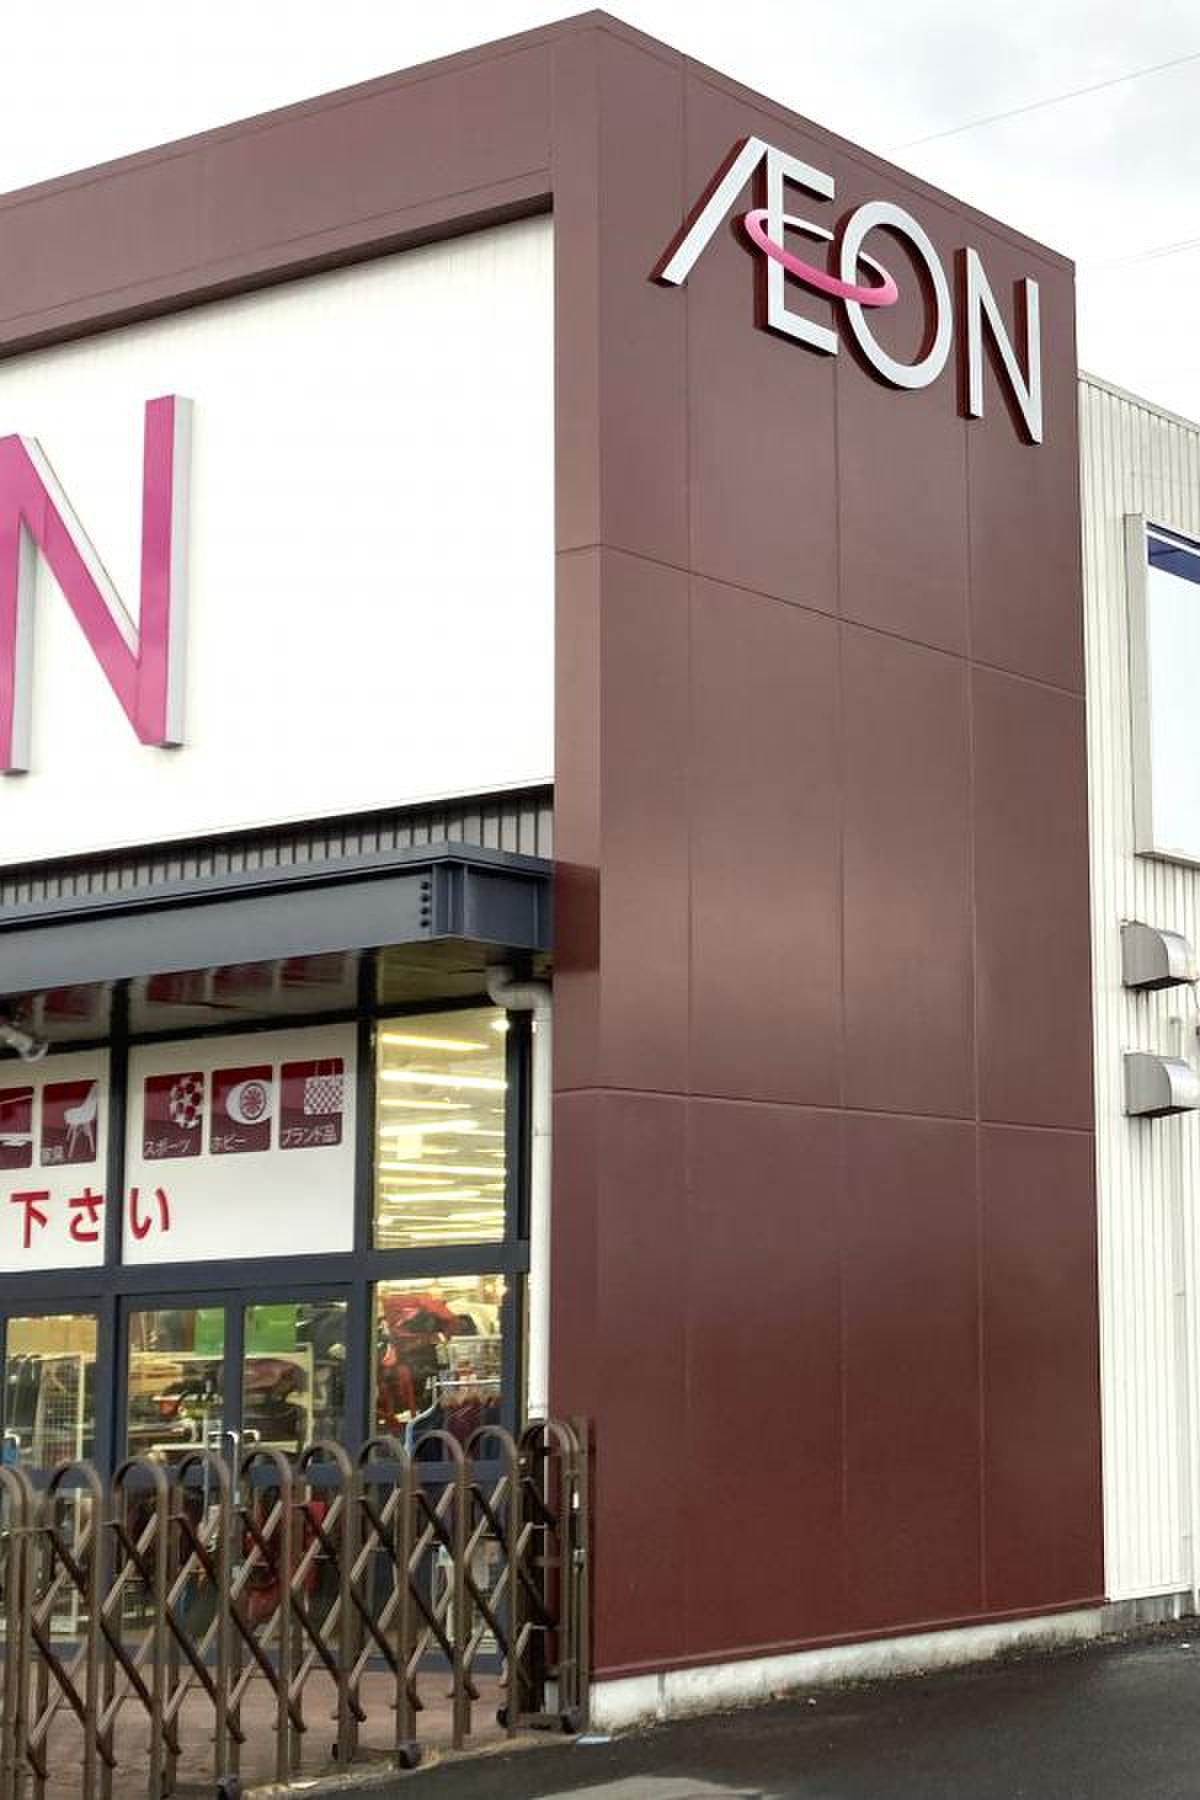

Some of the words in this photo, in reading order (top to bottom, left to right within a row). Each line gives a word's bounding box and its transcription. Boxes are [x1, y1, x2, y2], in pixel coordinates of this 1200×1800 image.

[144, 1135, 192, 1157] スポーツ
[10, 1186, 170, 1249] 下さい
